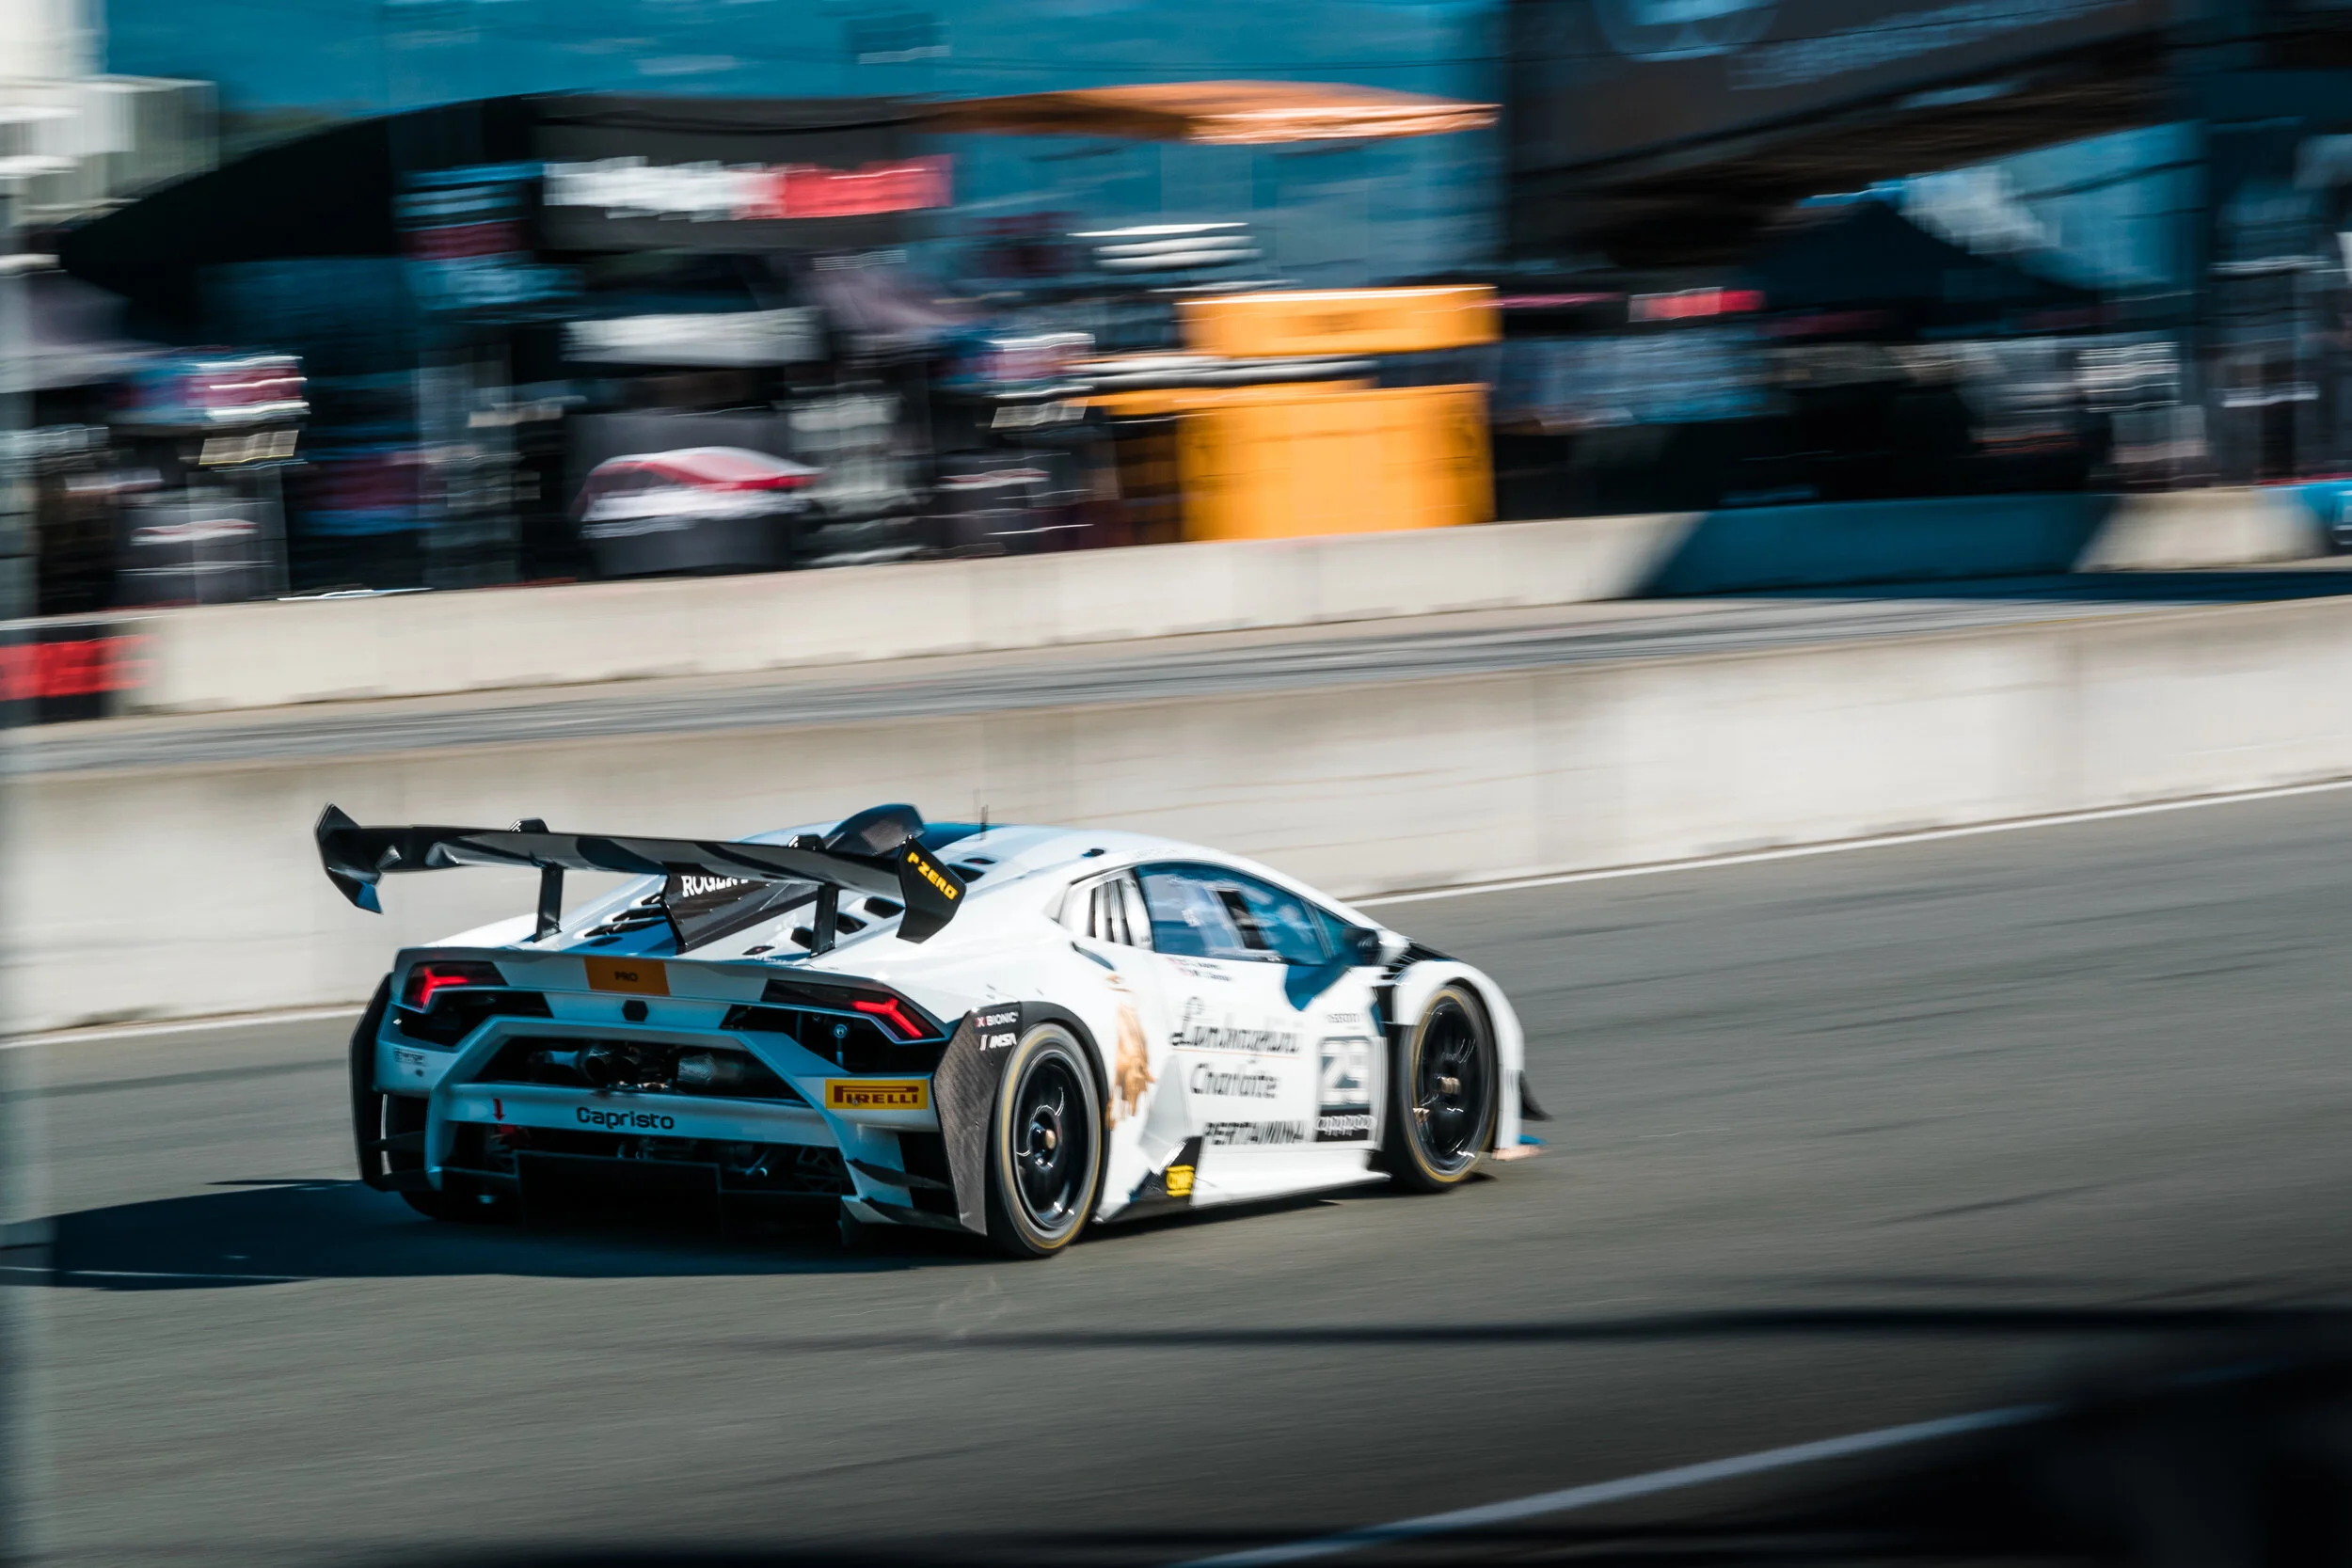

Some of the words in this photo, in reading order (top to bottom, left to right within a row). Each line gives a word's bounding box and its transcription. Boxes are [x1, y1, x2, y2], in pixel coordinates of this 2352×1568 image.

[917, 861, 959, 900] ZERO
[614, 971, 639, 983] PRO
[834, 1085, 919, 1103] PIRELLI
[576, 1107, 675, 1130] Capristo
